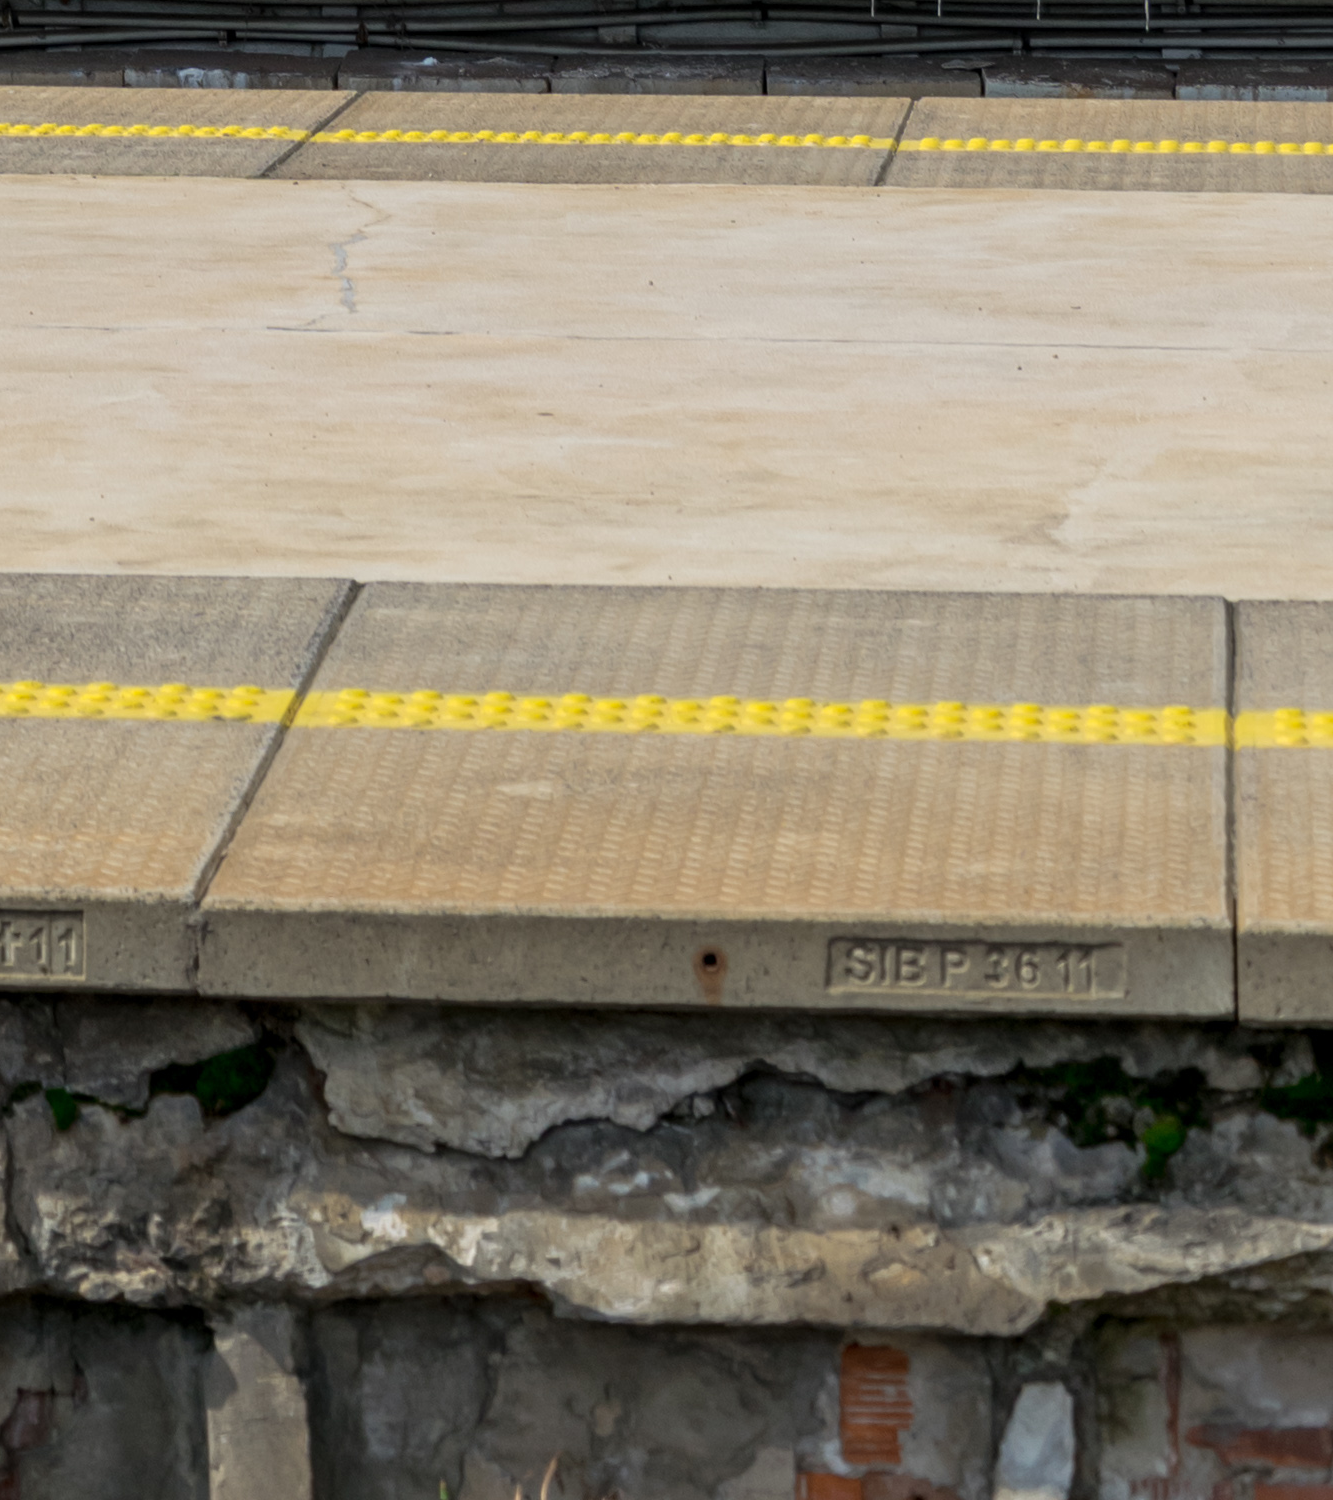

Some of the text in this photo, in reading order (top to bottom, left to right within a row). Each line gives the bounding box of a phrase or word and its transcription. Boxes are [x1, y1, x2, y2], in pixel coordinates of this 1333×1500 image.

[29, 926, 76, 967] 11
[939, 948, 971, 988] P
[1055, 950, 1096, 993] 11
